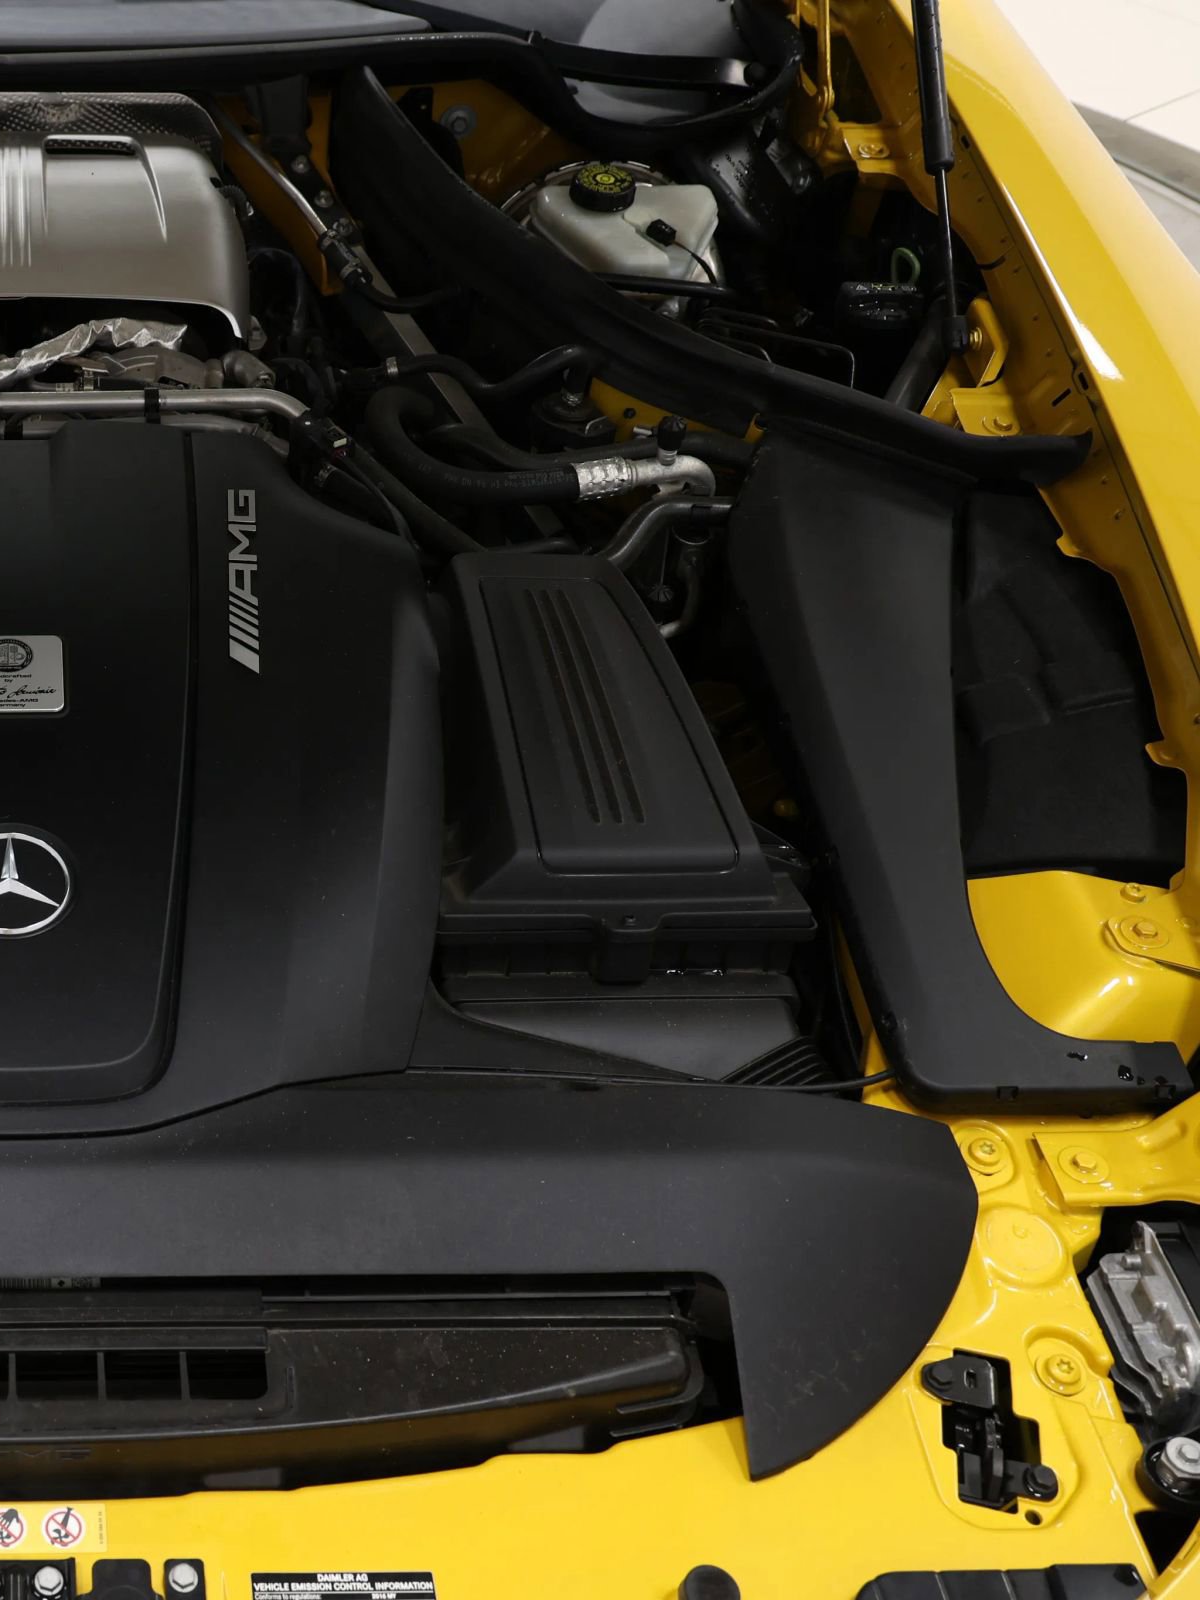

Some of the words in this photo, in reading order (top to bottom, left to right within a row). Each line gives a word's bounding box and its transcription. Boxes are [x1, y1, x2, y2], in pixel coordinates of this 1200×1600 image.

[228, 489, 258, 607] AMG
[316, 1573, 355, 1582] DAIMLER
[356, 1573, 369, 1582] AG
[253, 1582, 290, 1591] VEHICLE
[291, 1582, 333, 1591] EMISSION
[333, 1582, 374, 1591] CONTROL
[375, 1581, 433, 1590] INFORMATION
